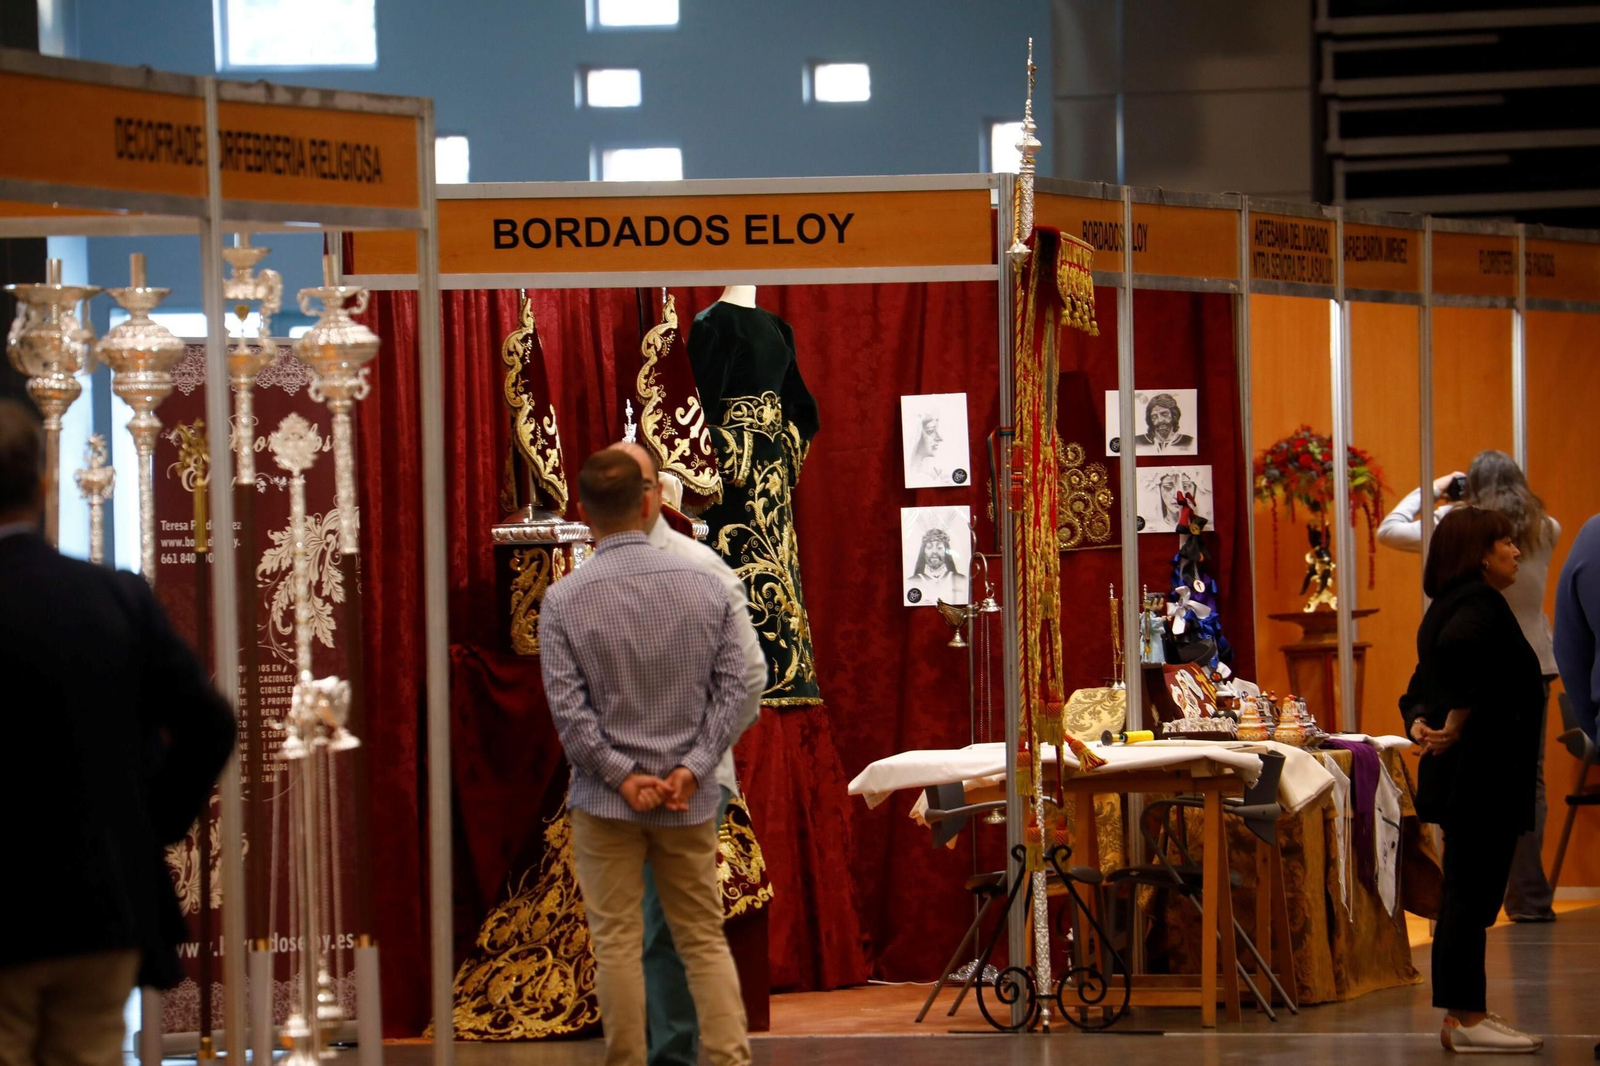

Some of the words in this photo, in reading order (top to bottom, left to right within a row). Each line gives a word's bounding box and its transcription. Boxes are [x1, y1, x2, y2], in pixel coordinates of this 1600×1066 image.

[114, 117, 204, 167] DECOFRADE
[308, 138, 384, 184] RELIGIOSA
[493, 215, 730, 249] BORDADOS
[744, 213, 854, 245] ELOY
[1131, 222, 1148, 252] LOY
[160, 520, 188, 531] Teresa
[160, 552, 178, 564] 661
[180, 552, 197, 563] 840
